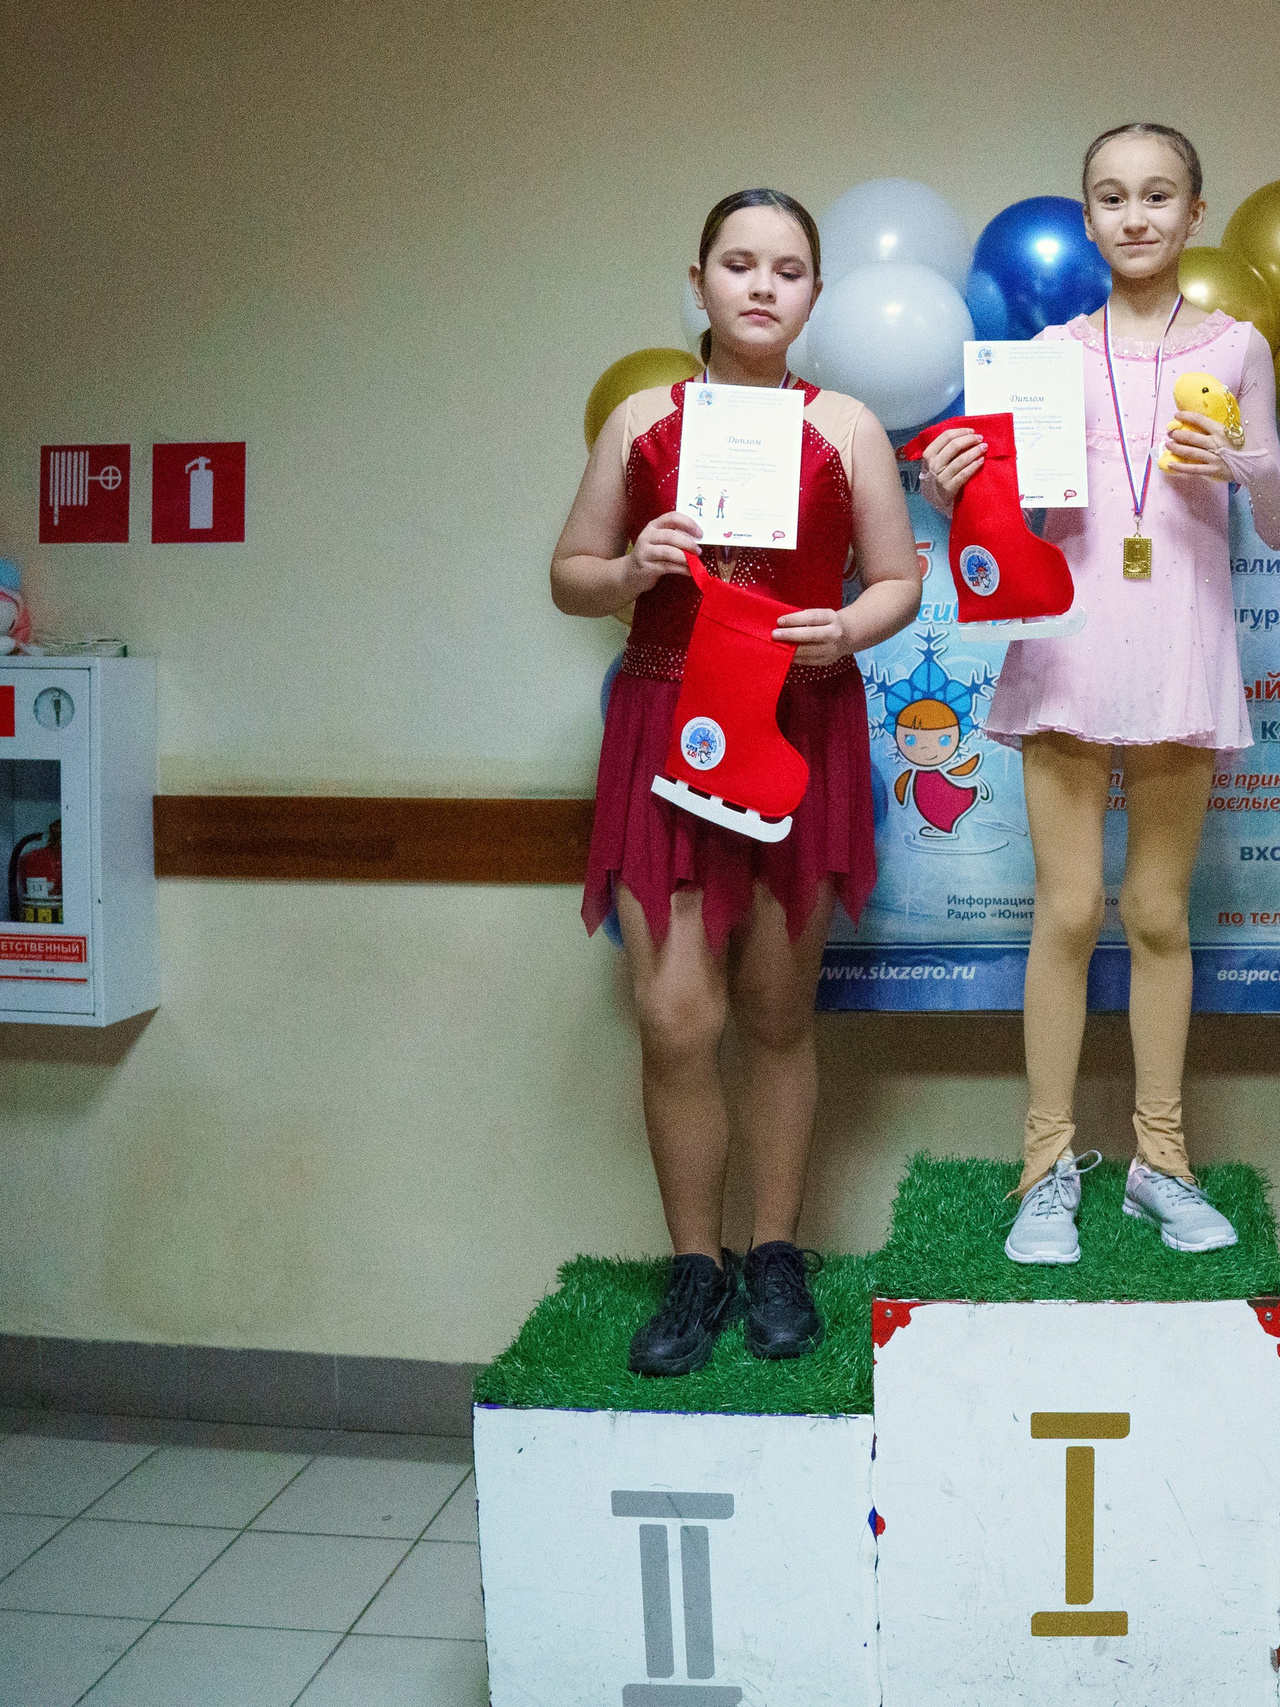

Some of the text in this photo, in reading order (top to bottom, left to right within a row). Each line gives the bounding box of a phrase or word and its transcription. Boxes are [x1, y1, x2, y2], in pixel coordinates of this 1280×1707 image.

[1009, 394, 1045, 404] Диплом
[726, 435, 762, 446] Диплом
[947, 894, 1035, 908] Информацио
[947, 908, 1035, 921] Радио «Юнит
[1218, 911, 1244, 925] по
[1, 942, 80, 954] ЕТСТВЕННЫЙ
